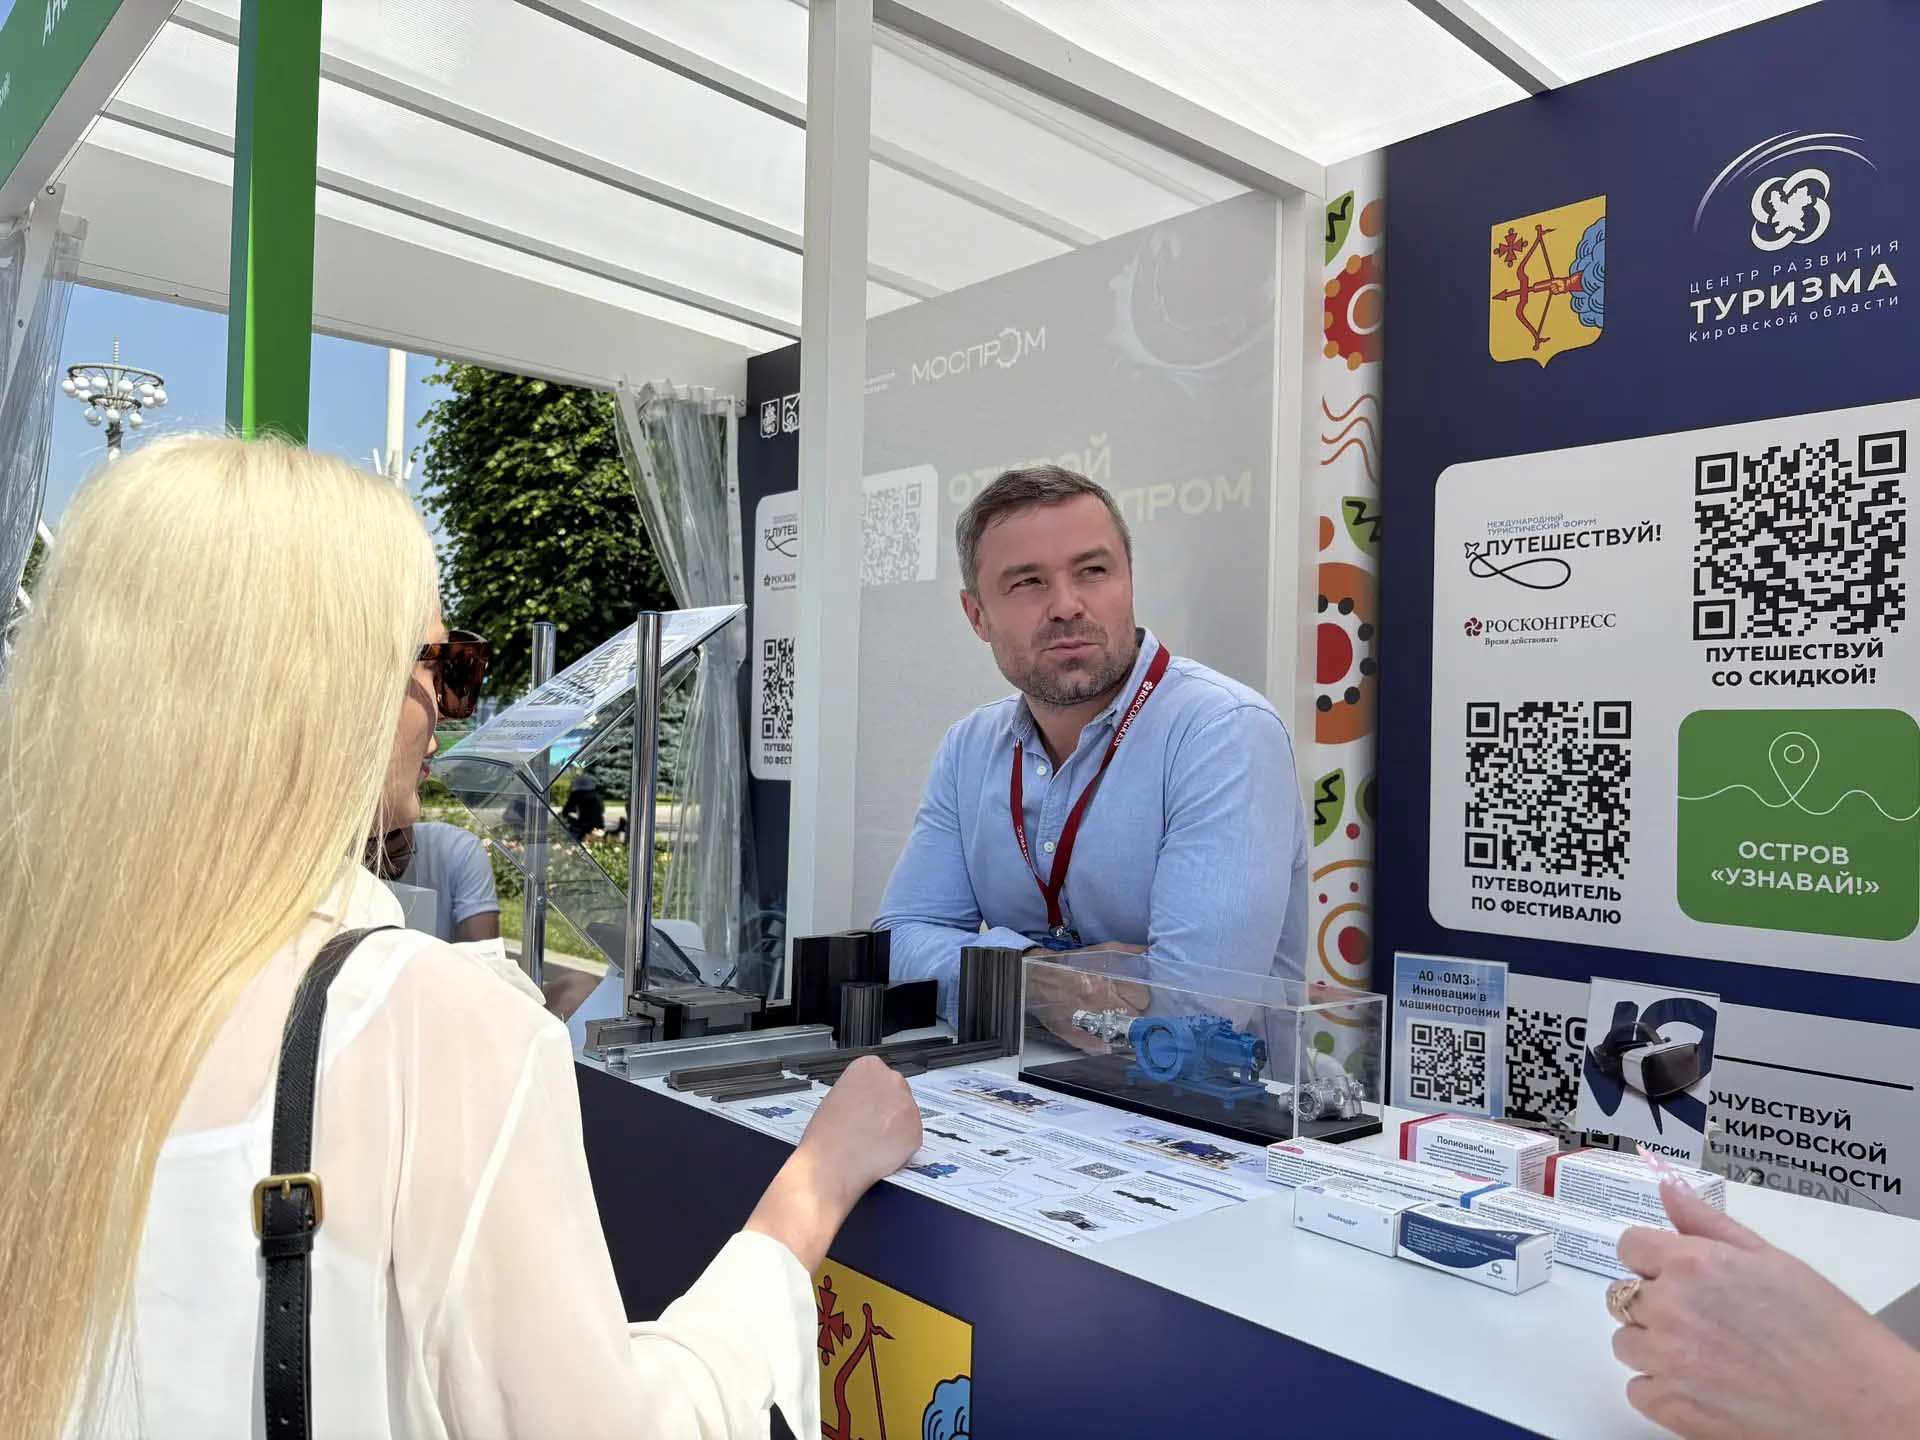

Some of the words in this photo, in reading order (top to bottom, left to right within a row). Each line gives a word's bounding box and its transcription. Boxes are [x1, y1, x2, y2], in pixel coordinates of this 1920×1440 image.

[1690, 269, 1759, 294] ЦЕНТР
[1772, 240, 1900, 276] РАЗВИТИЯ
[1689, 263, 1898, 324] ТУРИЗМА
[1688, 312, 1798, 342] Кировской
[1809, 295, 1899, 320] области
[911, 327, 1046, 384] МОСПРОМ
[1487, 513, 1564, 529] МЕЖДУНАРОДНЫЙ
[1487, 520, 1560, 536] ТУРИСТИЧЕСКИЙ
[1562, 518, 1597, 529] ФОРУМ
[1486, 520, 1662, 556] ПУТЕШЕСТВУЙ!
[1485, 613, 1617, 633] РОСКОНГРЕСС
[1484, 637, 1509, 648] Время
[1510, 636, 1559, 646] действовать
[1706, 637, 1884, 663] ПУТЕШЕСТВУЙ
[1711, 670, 1743, 687] СО
[1749, 664, 1876, 688] СКИДКОЙ!
[1738, 840, 1850, 865] ОСТРОВ
[1472, 875, 1622, 902] ПУТЕВОДИТЕЛЬ
[1711, 867, 1881, 896] «УЗНАВАЙ!»
[1471, 896, 1496, 912] ПО
[1501, 899, 1622, 925] ФЕСТИВАЛЮ
[1418, 969, 1434, 982] АО
[1412, 984, 1477, 1001] Инновации
[1479, 993, 1488, 1002] в
[1399, 999, 1501, 1019] машиностроении
[1725, 1119, 1888, 1165] КИРОВСКОЙ
